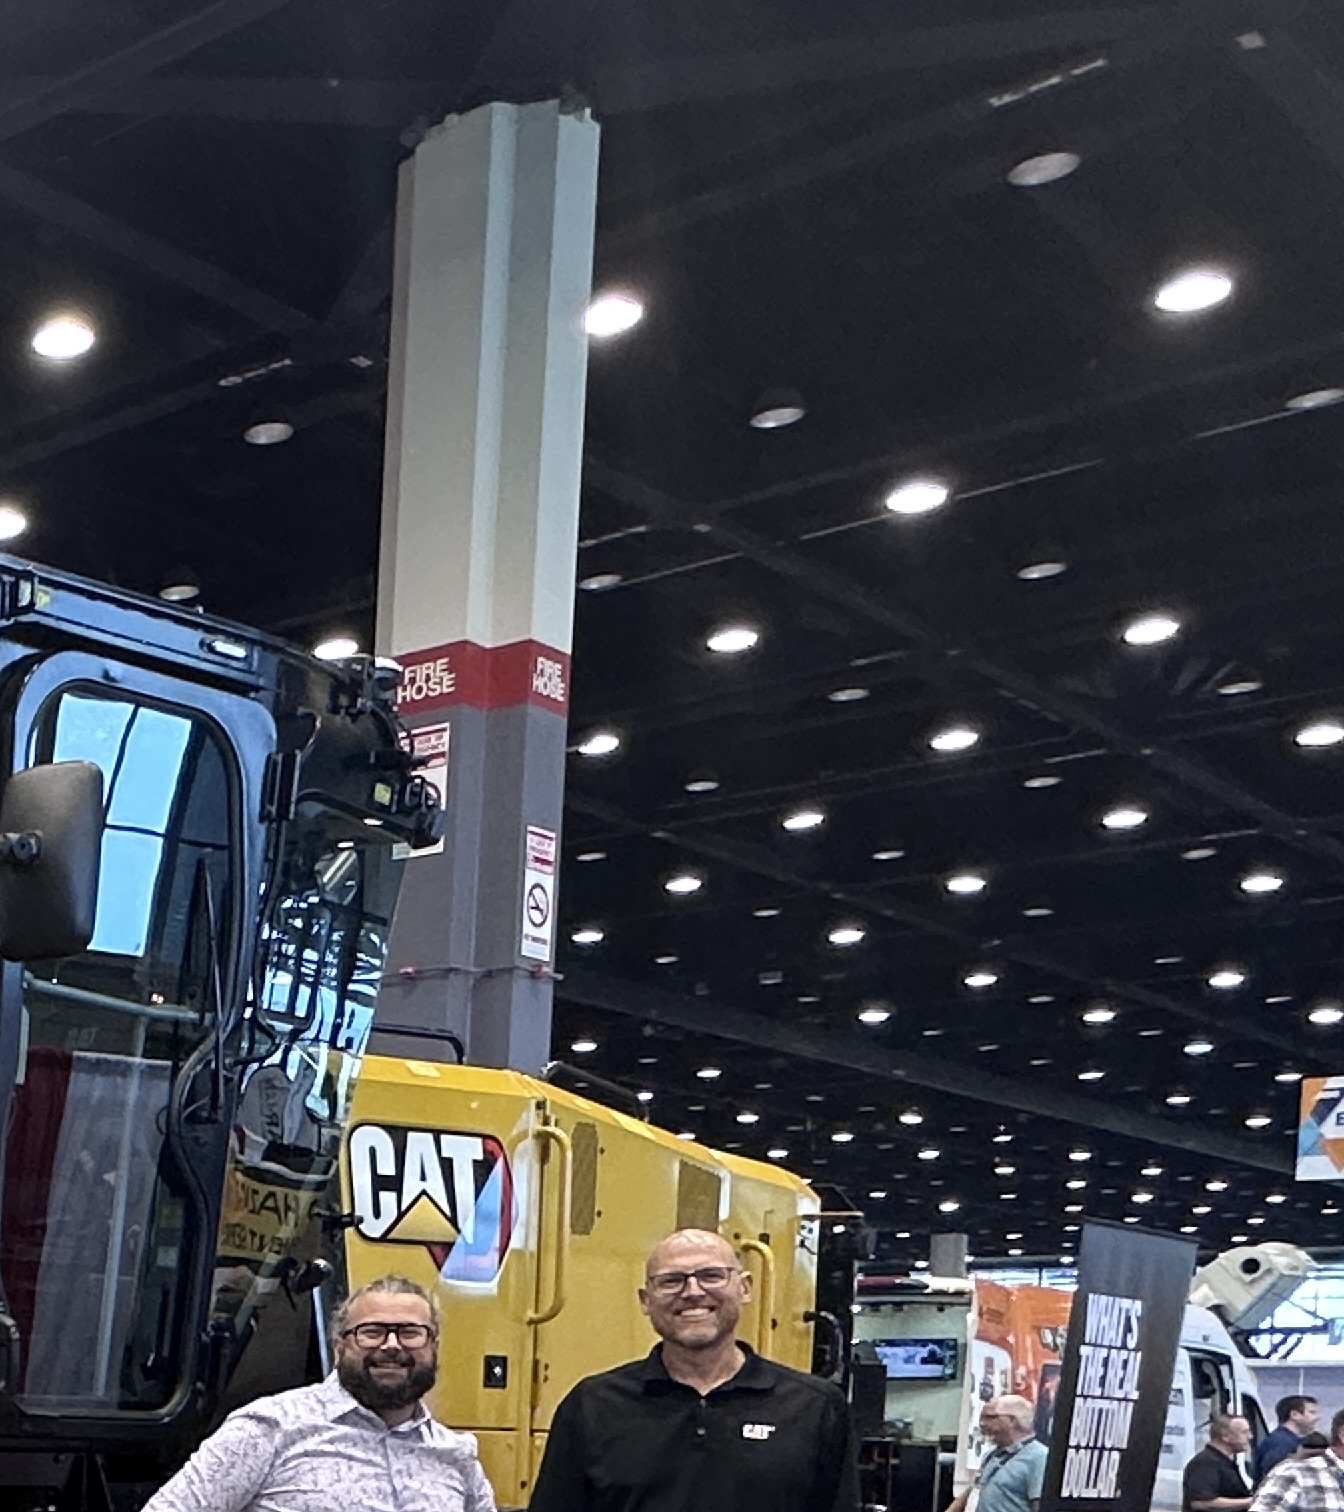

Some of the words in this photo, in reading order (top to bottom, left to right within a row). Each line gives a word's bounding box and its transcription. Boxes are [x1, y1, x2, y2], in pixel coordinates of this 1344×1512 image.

[396, 673, 456, 704] HOSE
[404, 657, 450, 685] FIRE
[532, 672, 566, 702] HOSE
[536, 656, 562, 681] FIRE
[350, 1125, 484, 1245] CAT
[1084, 1292, 1142, 1350] WHAT'S
[1076, 1344, 1109, 1396] THE
[1104, 1348, 1142, 1400] REAL
[1068, 1396, 1134, 1450] BOTTOM
